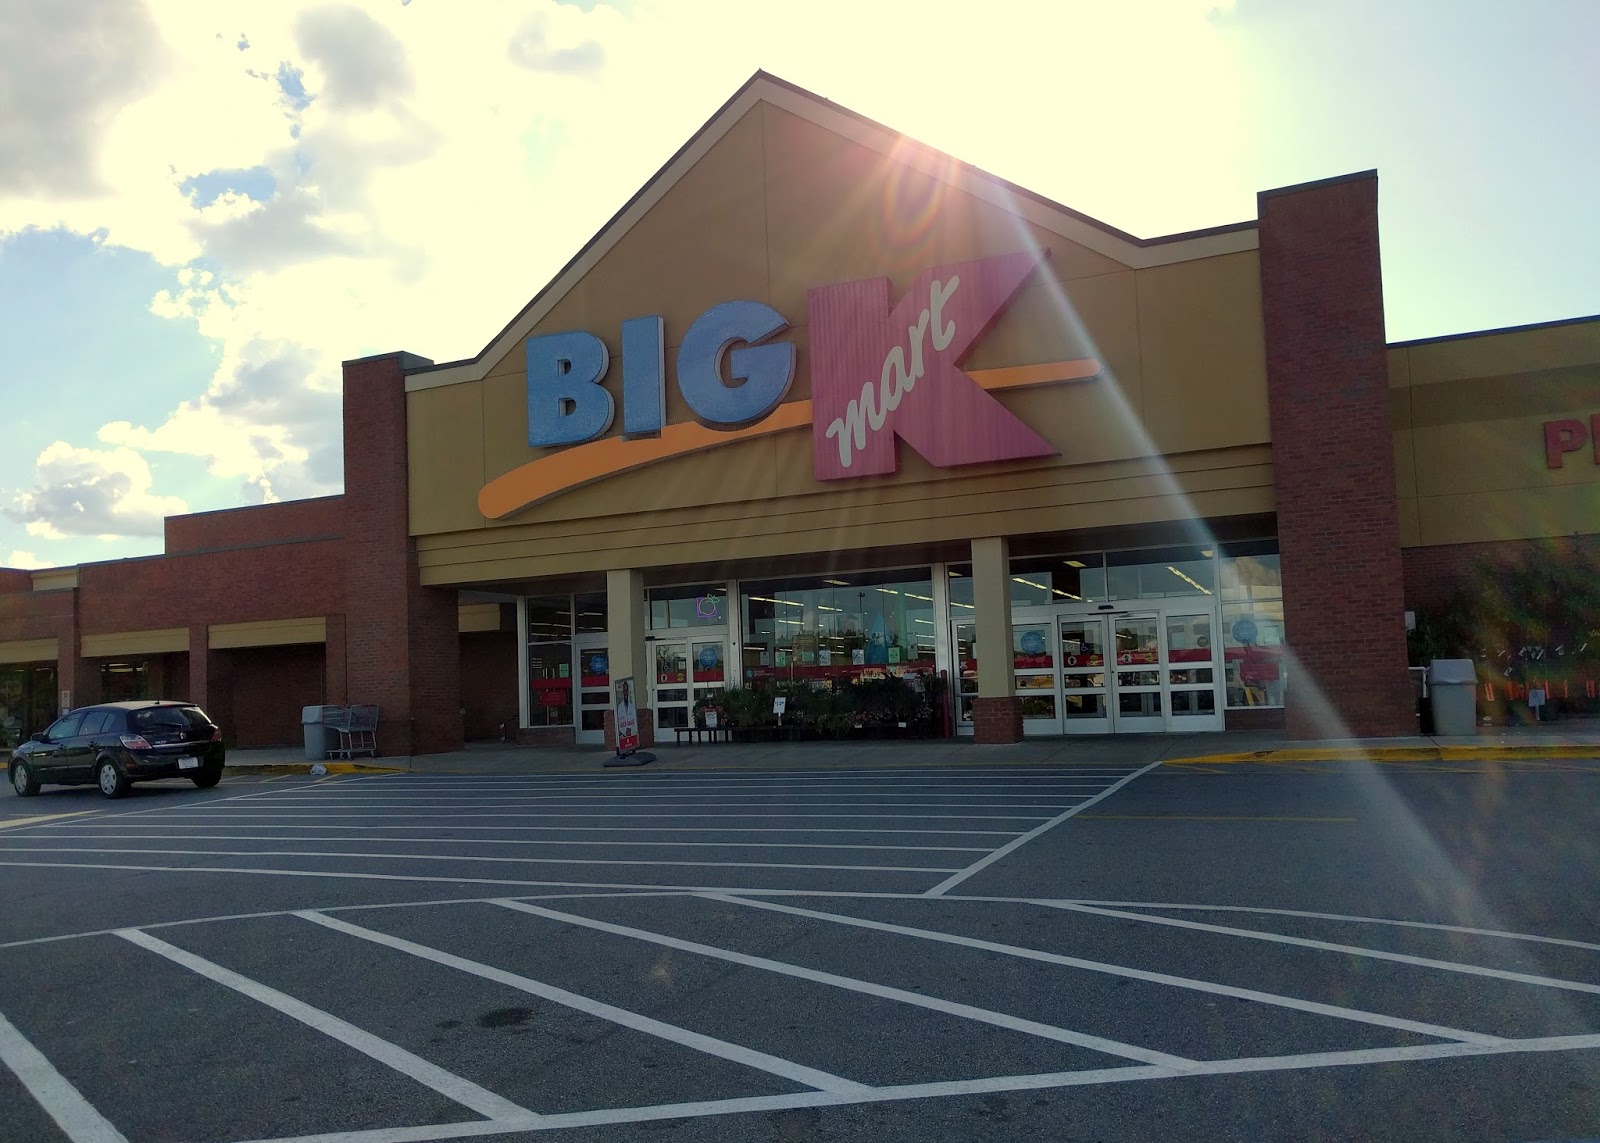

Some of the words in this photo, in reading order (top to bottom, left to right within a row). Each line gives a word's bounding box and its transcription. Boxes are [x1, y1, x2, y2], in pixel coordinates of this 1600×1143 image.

[526, 299, 797, 448] BIG
[807, 246, 1062, 482] K
[825, 274, 960, 468] mart
